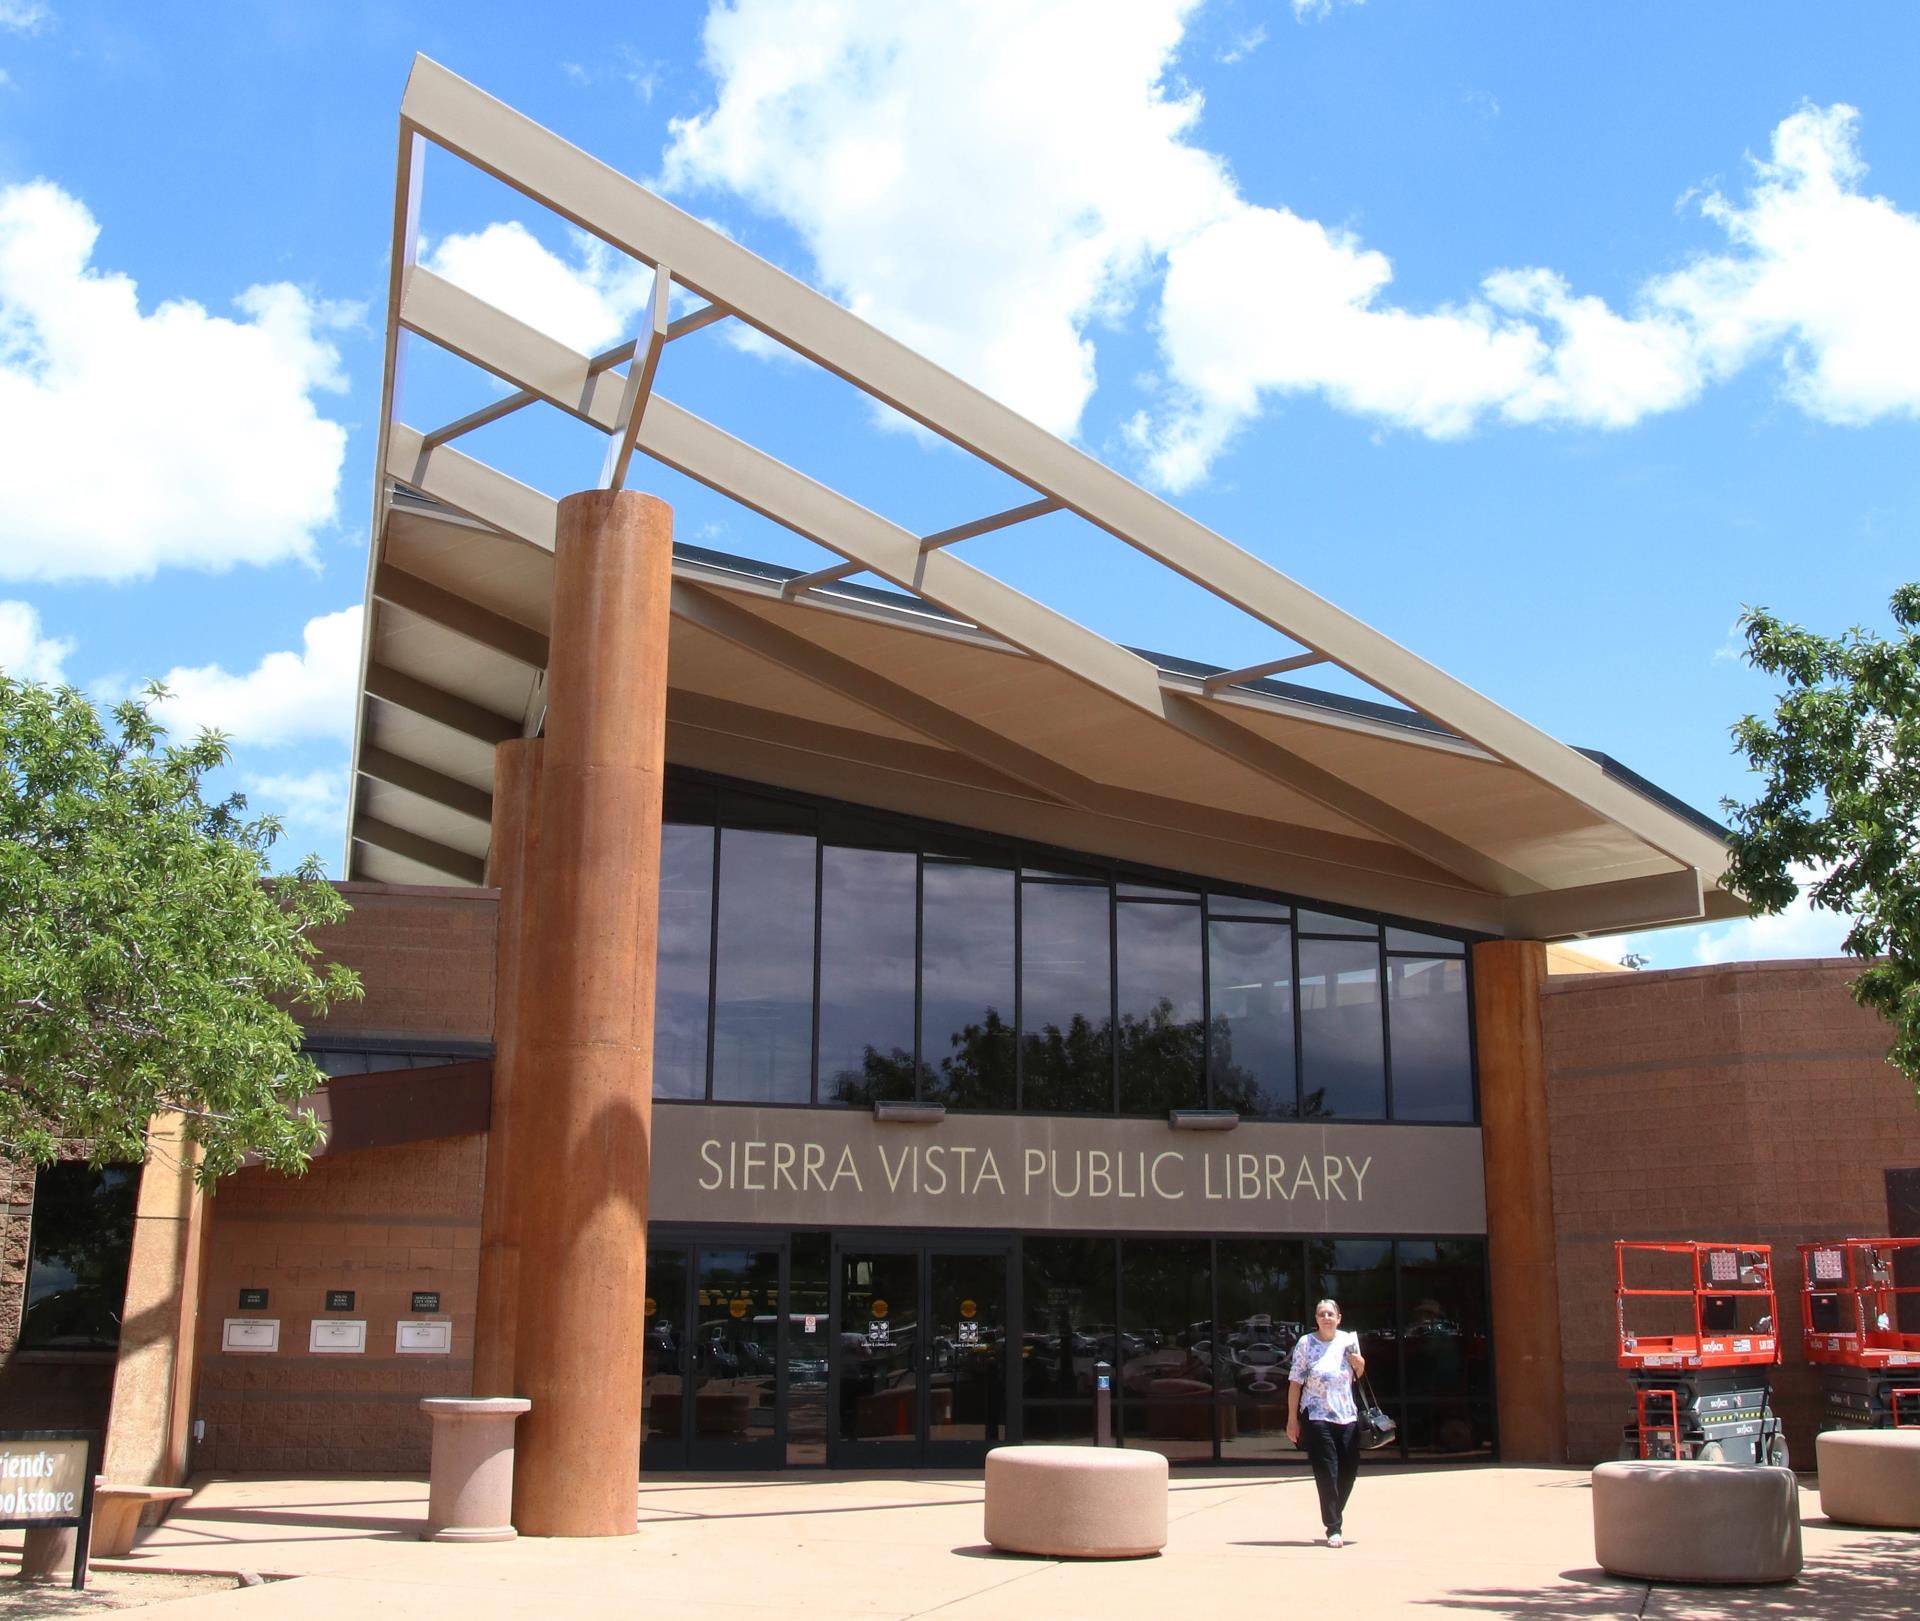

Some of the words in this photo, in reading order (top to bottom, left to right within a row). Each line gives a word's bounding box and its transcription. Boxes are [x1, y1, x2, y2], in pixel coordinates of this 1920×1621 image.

[699, 1140, 863, 1191] SIERRA
[878, 1145, 1005, 1195] VISTA
[1024, 1149, 1184, 1199] PUBLIC
[1204, 1153, 1373, 1201] LIBRARY
